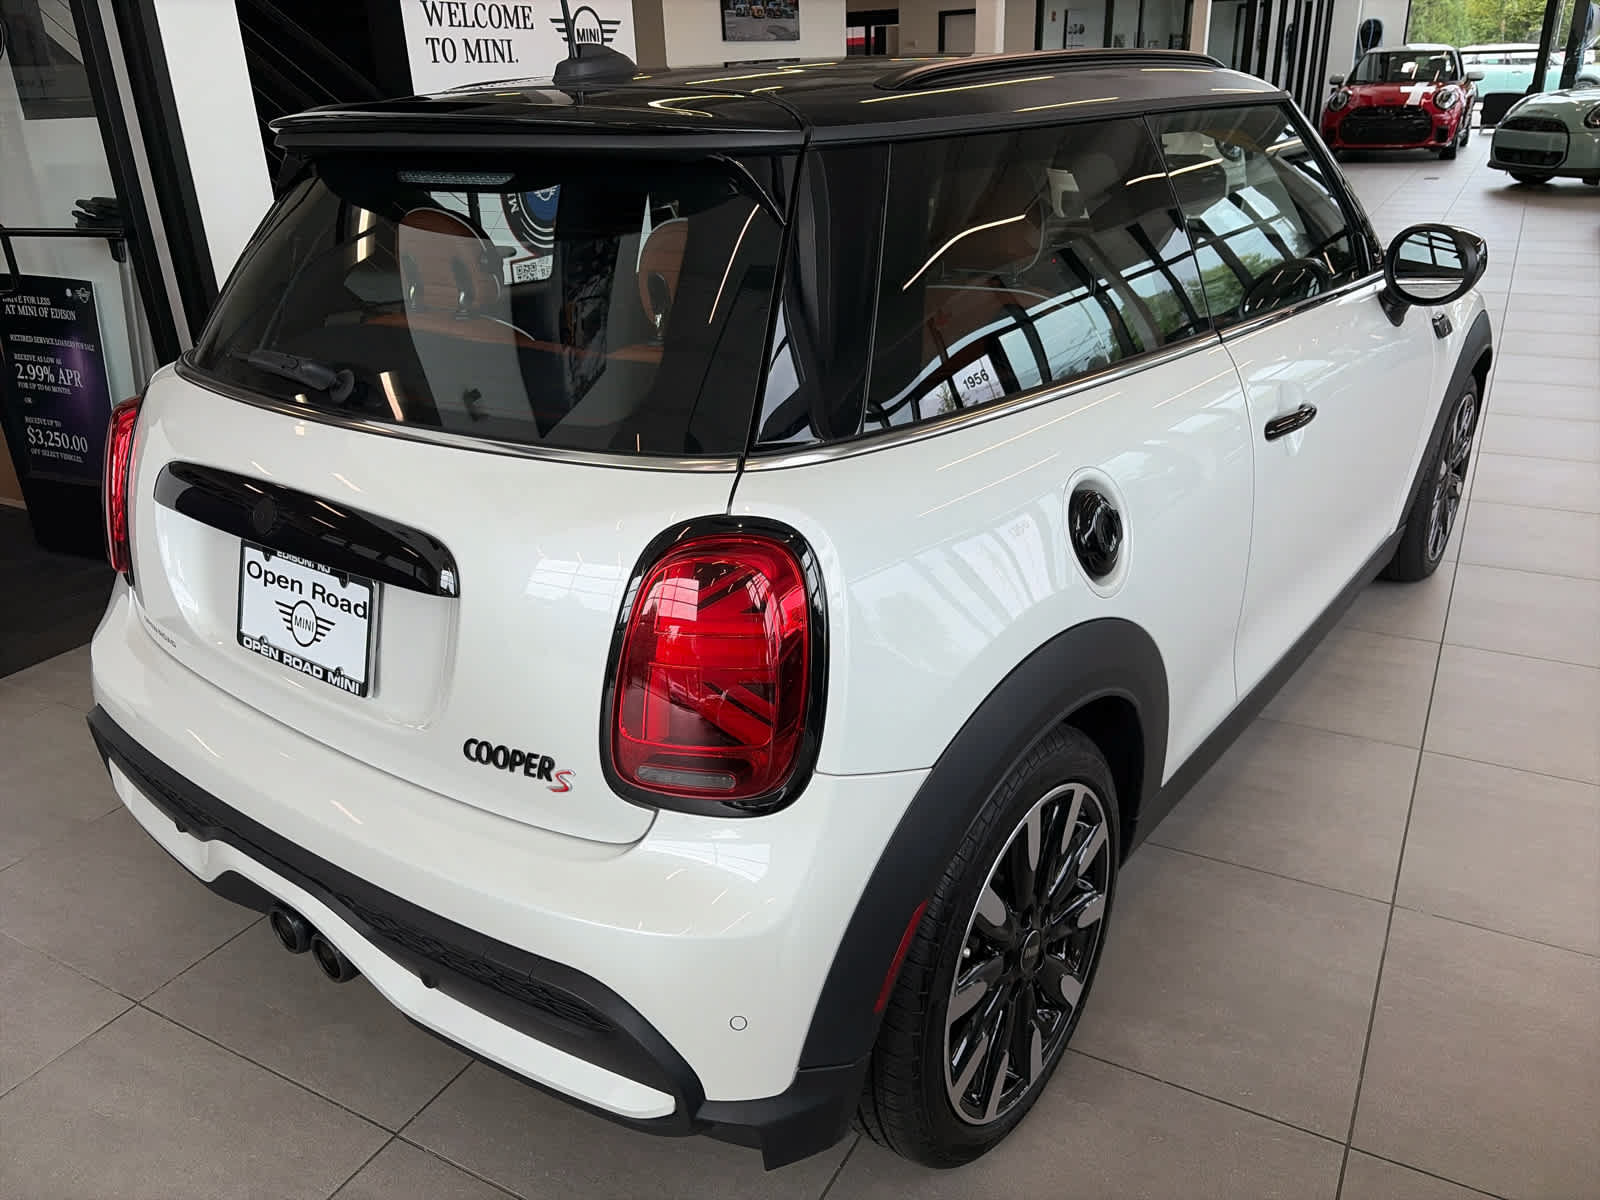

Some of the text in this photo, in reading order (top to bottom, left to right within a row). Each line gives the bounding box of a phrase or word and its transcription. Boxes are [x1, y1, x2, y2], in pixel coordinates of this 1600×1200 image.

[420, 0, 534, 30] WELCOME
[576, 28, 600, 43] MINI
[425, 37, 519, 64] TO MINI.
[5, 304, 77, 321] AT MINI OF EDISON
[15, 363, 84, 388] 2.99% APR
[963, 368, 989, 390] 1956
[27, 425, 88, 453] $3,250.00
[317, 563, 331, 574] NJ
[246, 560, 368, 620] Open Road
[294, 615, 315, 633] MINI
[243, 636, 360, 695] OPEN ROAD MINI
[463, 738, 577, 793] COOPER S
